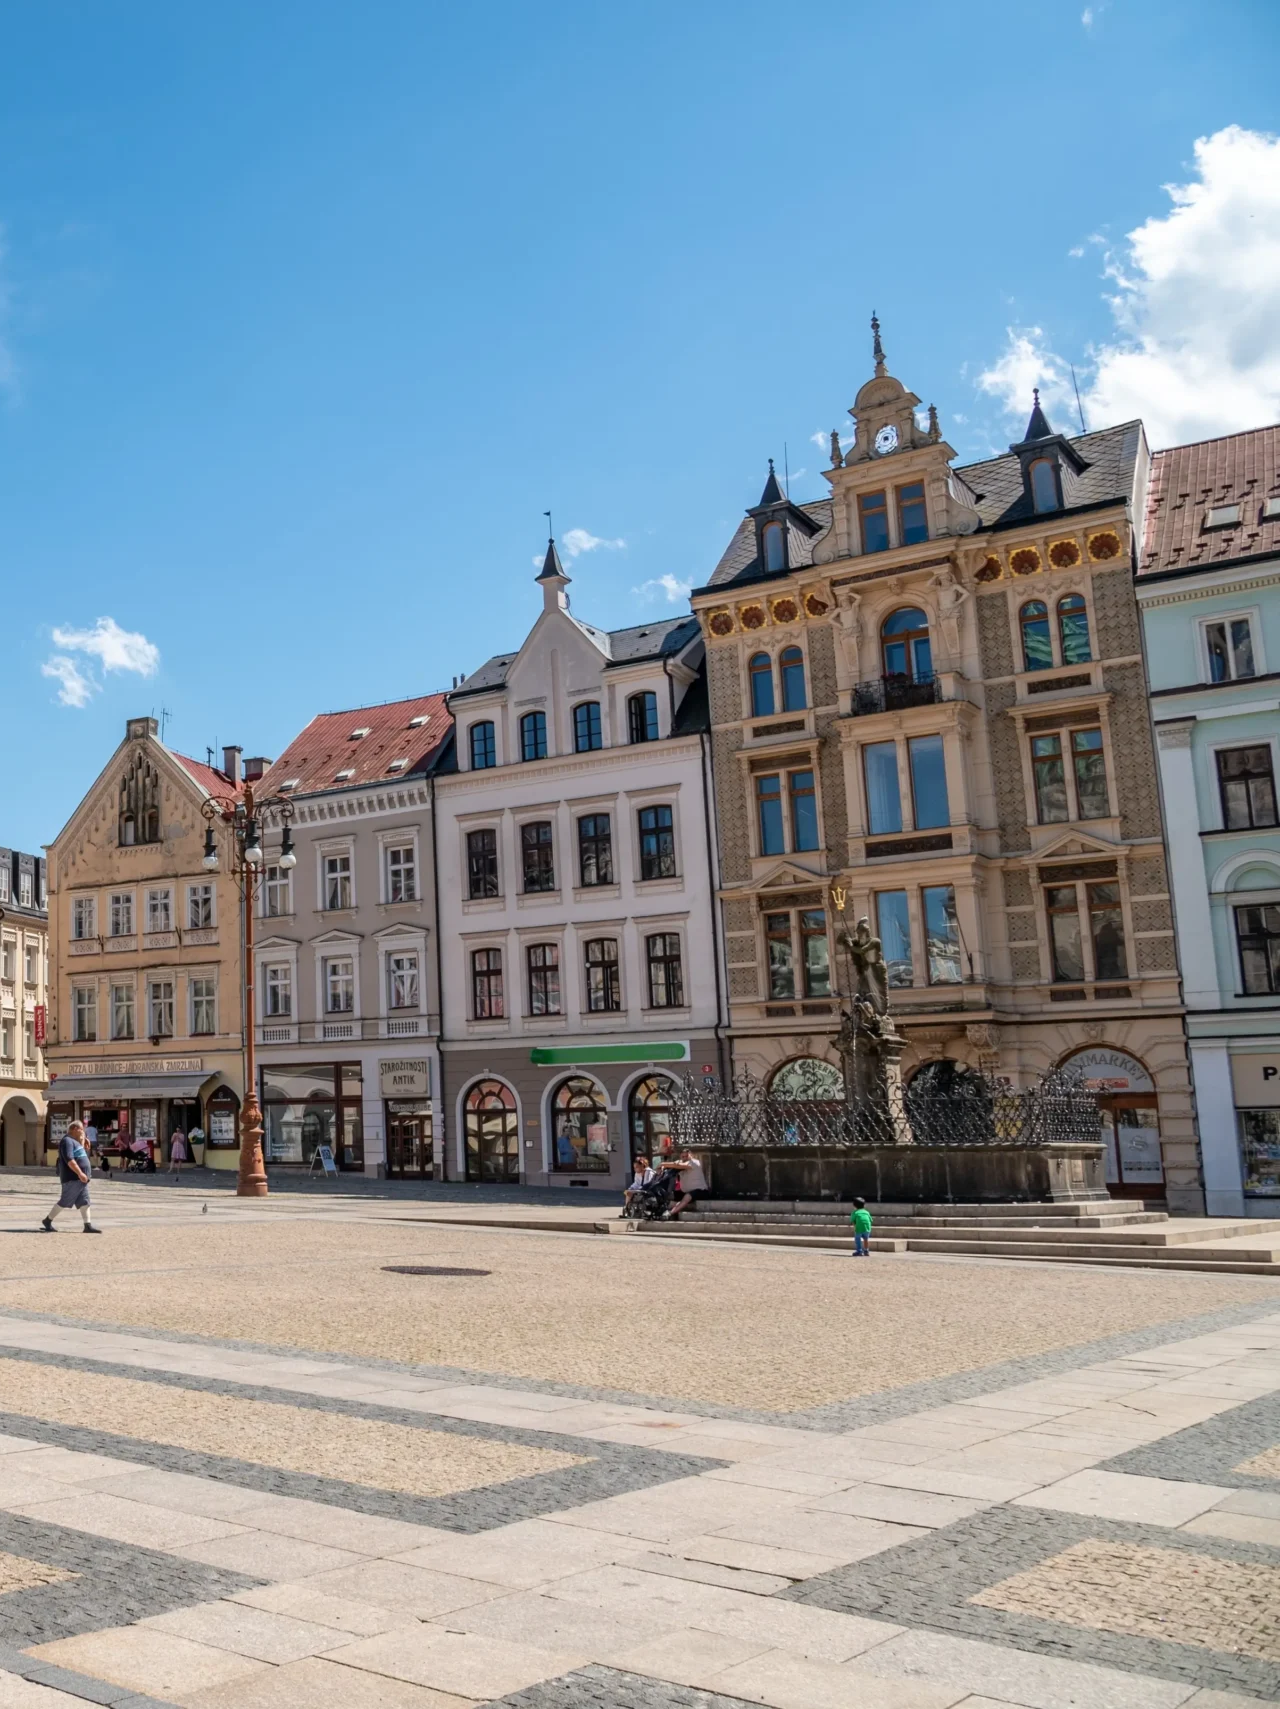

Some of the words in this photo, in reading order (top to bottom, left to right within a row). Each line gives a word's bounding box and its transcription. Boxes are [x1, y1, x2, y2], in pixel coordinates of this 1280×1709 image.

[69, 1064, 87, 1074] PIZZA
[88, 1063, 93, 1073] U
[166, 1060, 200, 1071] ZMRZLINA
[380, 1060, 427, 1076] STAROŽITNOSTI
[1060, 1053, 1148, 1082] INIMARKET
[392, 1075, 416, 1085] ANTIK
